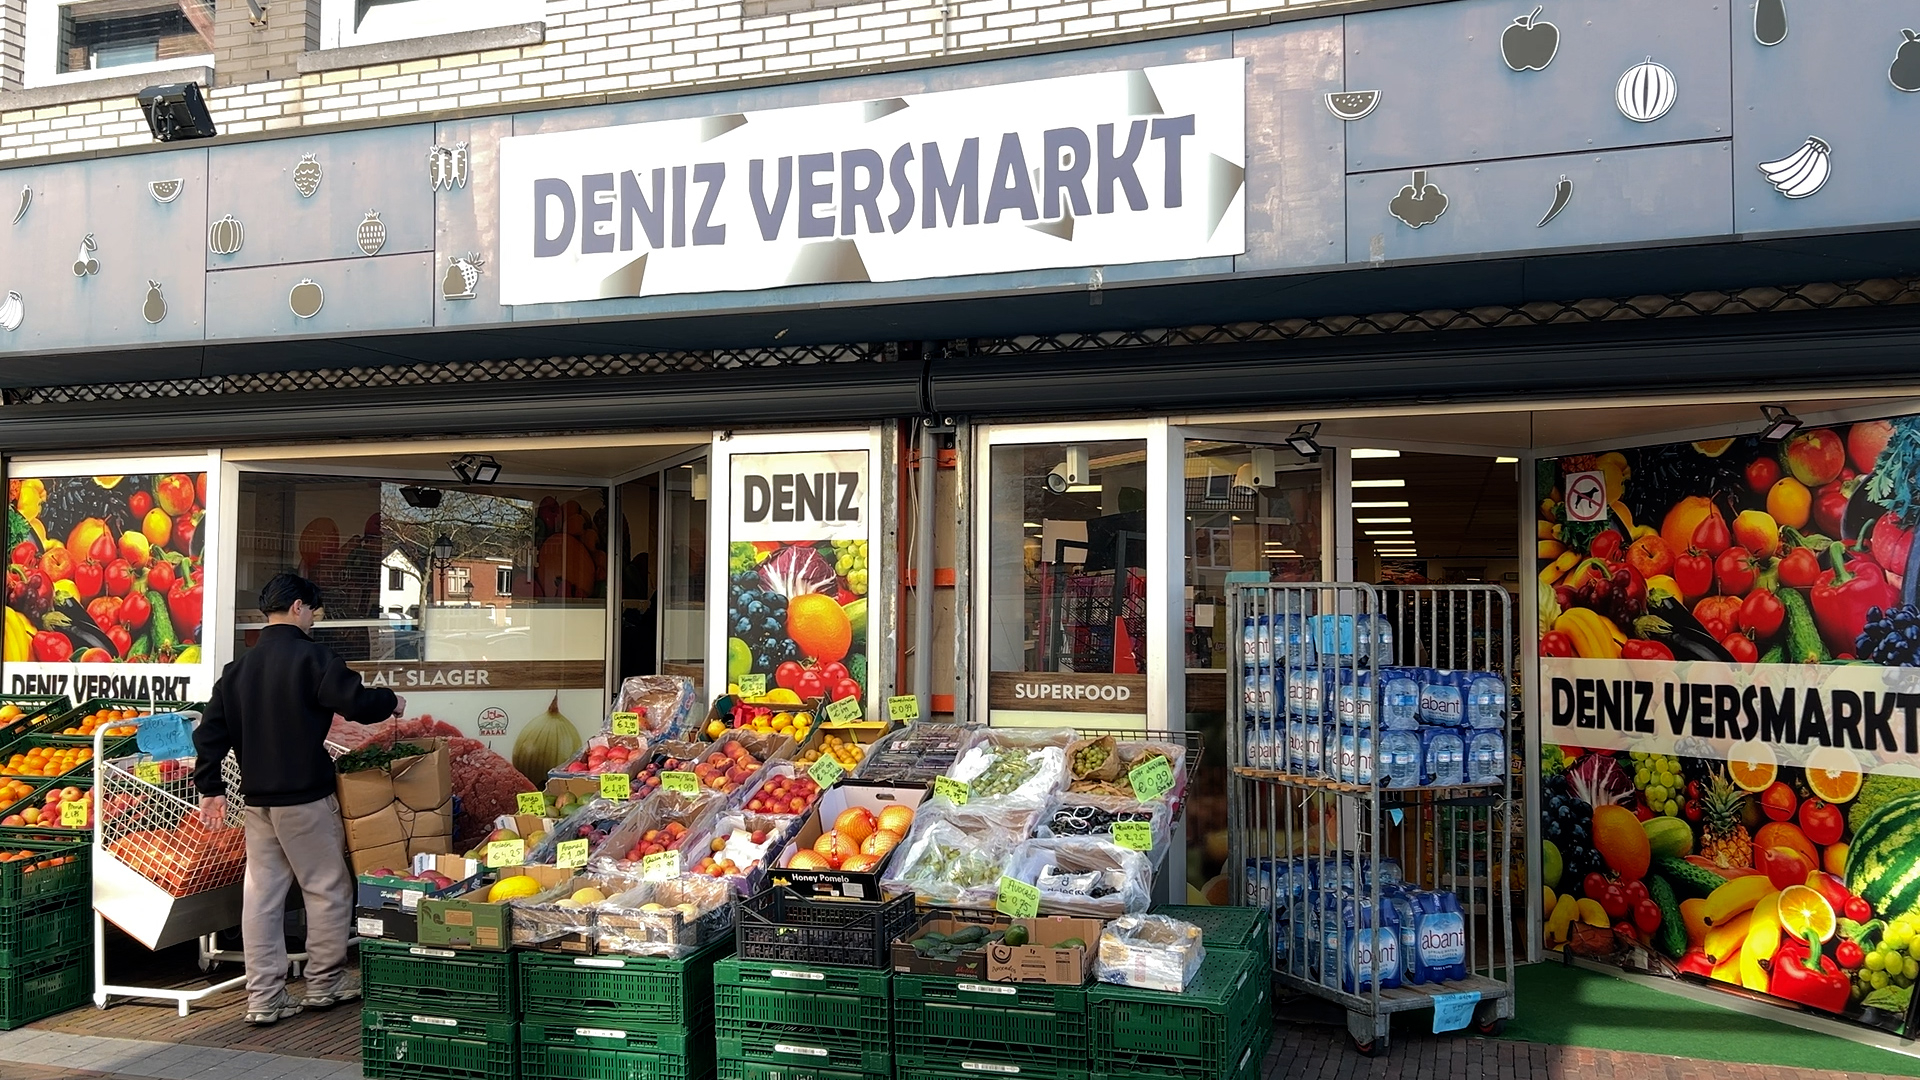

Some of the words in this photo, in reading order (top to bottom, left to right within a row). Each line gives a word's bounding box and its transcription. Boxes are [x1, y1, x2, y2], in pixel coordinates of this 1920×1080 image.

[533, 162, 727, 258] DENIZ
[749, 114, 1195, 242] VERSMARKT
[743, 471, 860, 523] DENIZ
[12, 674, 69, 696] DENIZ
[74, 674, 191, 704] VERSMARKT
[361, 670, 400, 687] LAL
[406, 669, 490, 687] SLAGER
[1014, 683, 1131, 701] SUPERFOOD
[1421, 695, 1460, 715] abant
[1551, 677, 1655, 733] DENIZ
[1664, 681, 1920, 754] VERSMARKT
[791, 873, 818, 883] Honey
[819, 873, 850, 884] Pomelo
[1421, 928, 1464, 951] abant
[1358, 943, 1396, 965] abnt
